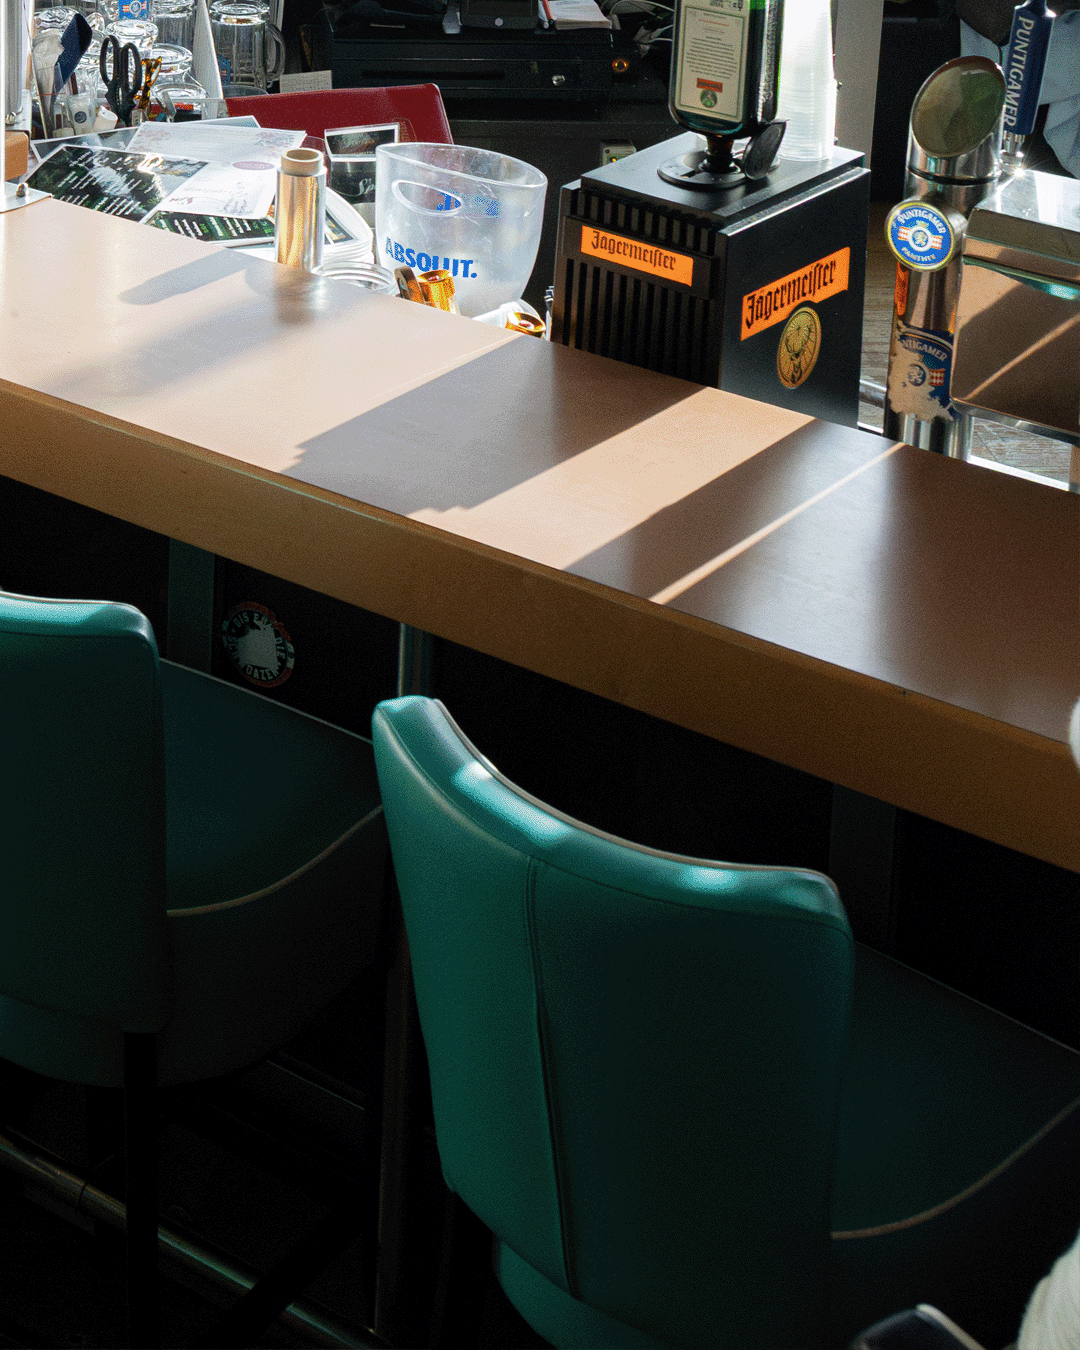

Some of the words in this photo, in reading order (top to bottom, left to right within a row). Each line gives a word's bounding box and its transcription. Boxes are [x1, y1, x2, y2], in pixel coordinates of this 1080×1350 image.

[1005, 16, 1035, 128] PUNTIGAMER
[897, 209, 946, 233] PUNTIGAMER
[591, 229, 676, 271] Jägermeister
[745, 258, 836, 330] Jägermeister
[902, 339, 948, 362] NTIGAMER
